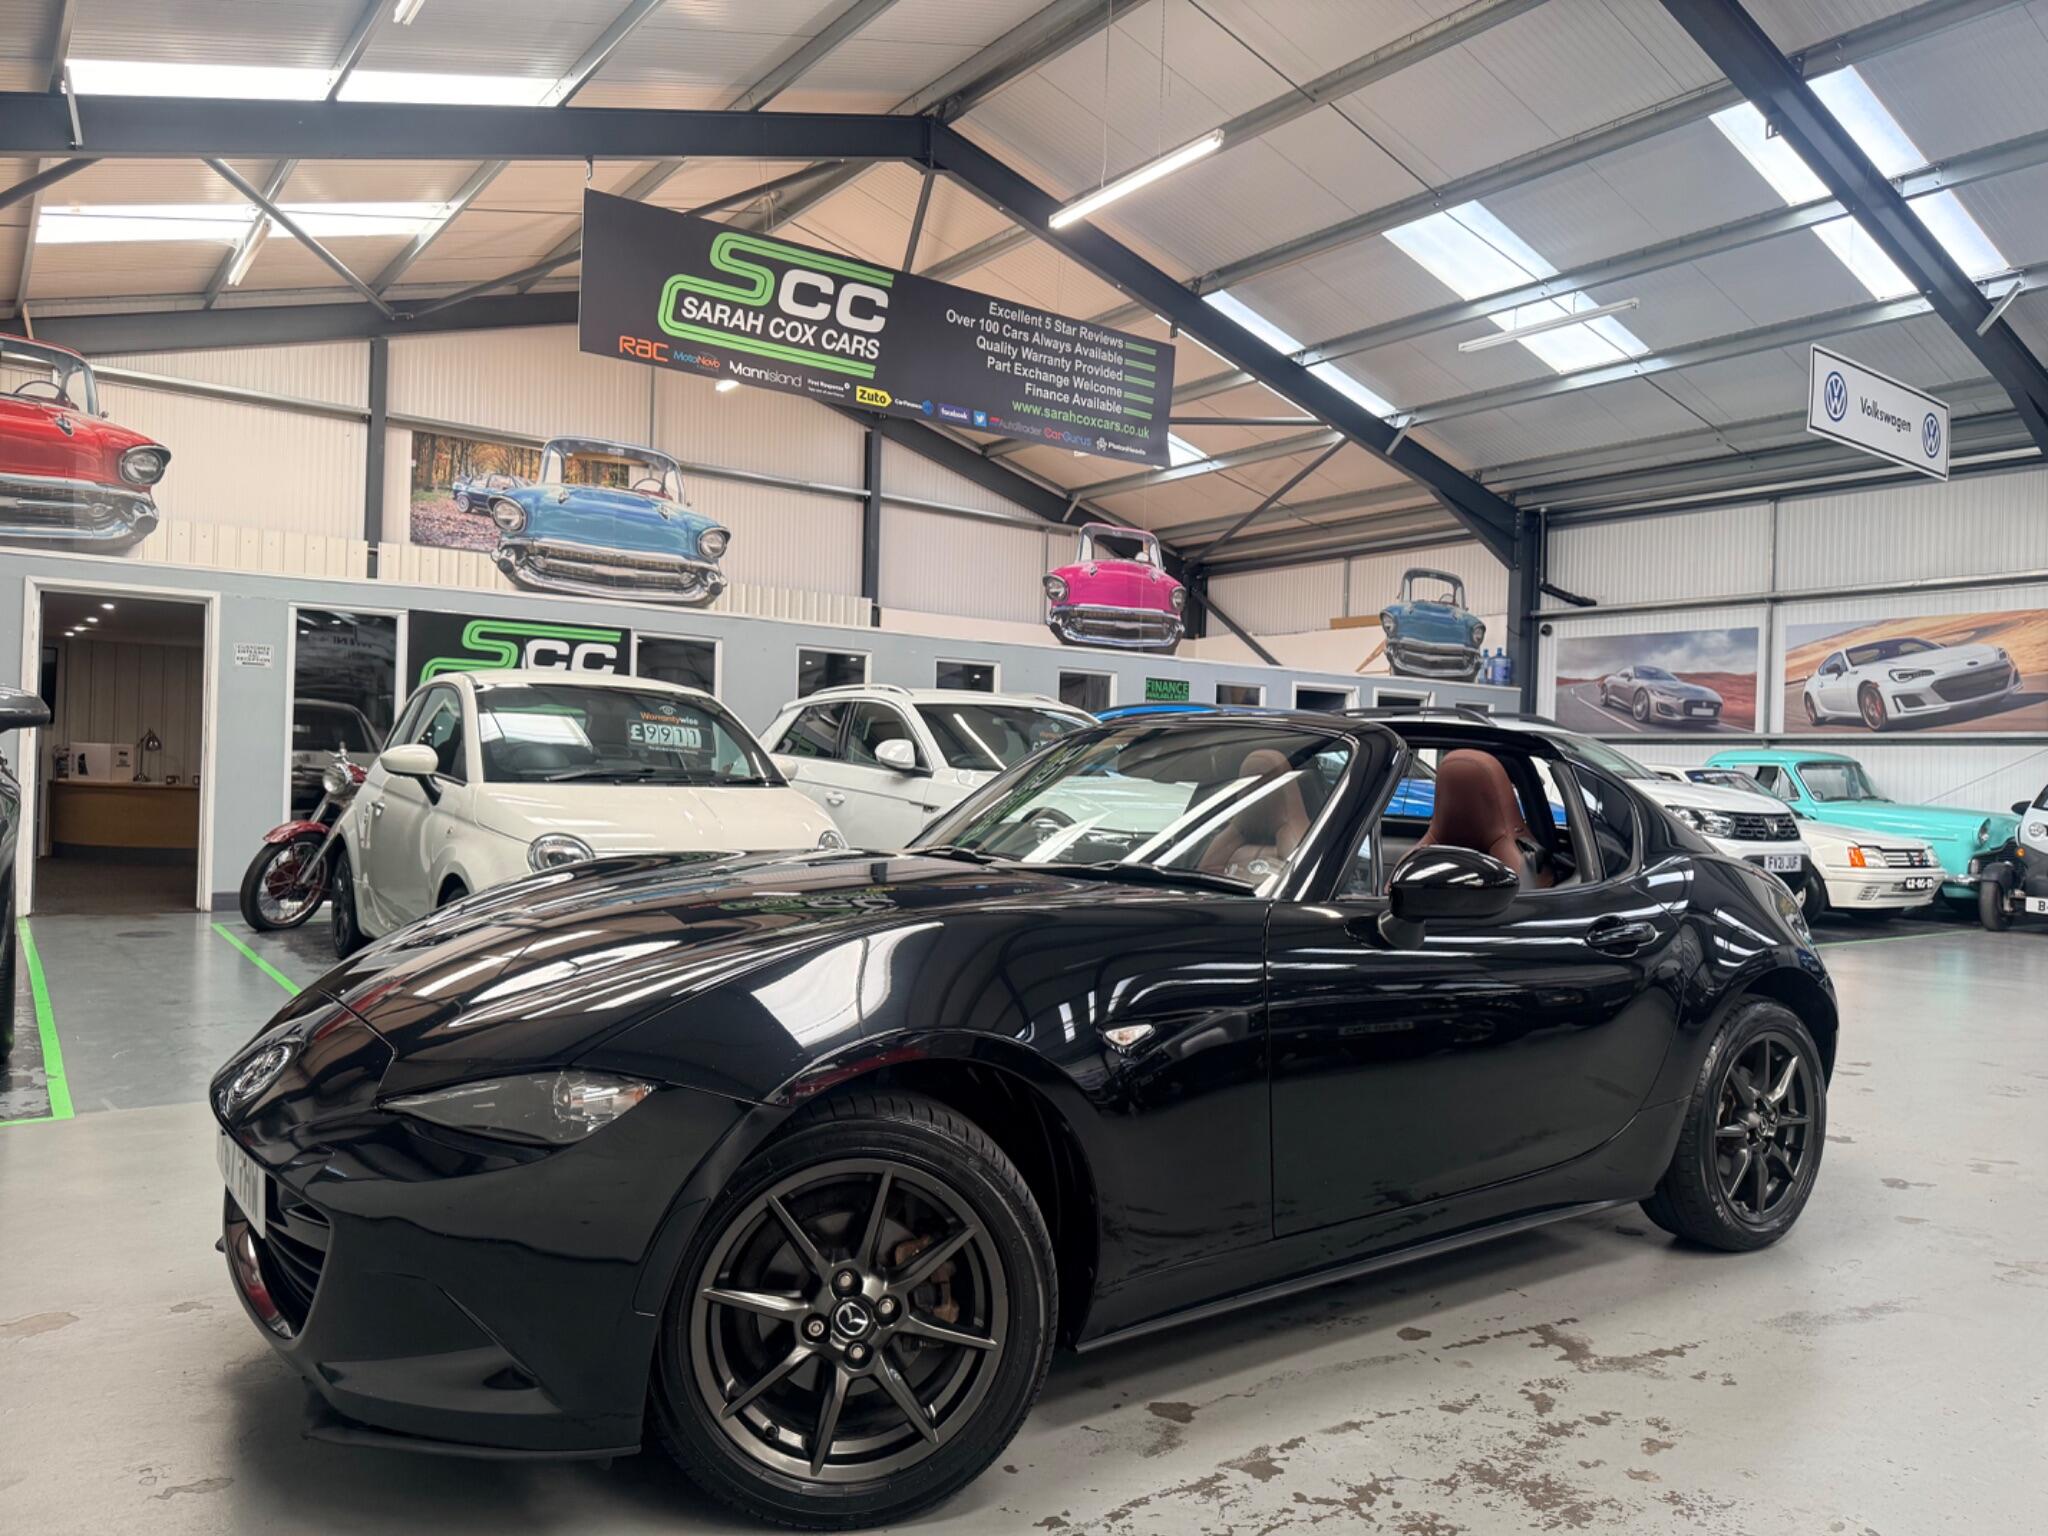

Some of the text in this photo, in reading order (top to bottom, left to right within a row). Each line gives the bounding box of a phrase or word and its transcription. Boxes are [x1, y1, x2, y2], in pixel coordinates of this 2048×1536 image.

[681, 297, 880, 360] SARAH COX CARS
[946, 309, 1123, 365] Over 100 Cars Always Available
[989, 302, 1123, 349] Excellent 5 Star Reviews
[976, 335, 1123, 381] Quality Warranty Provided
[987, 356, 1122, 398] Part Exchange Welcome
[859, 388, 887, 405] Zuto
[941, 407, 968, 420] facebook
[1025, 382, 1122, 414] Finance Available
[1860, 396, 1911, 432] Volkswagen
[1012, 400, 1149, 439] www.sarahcoxcars.co.uk
[1146, 680, 1188, 694] FINANCE
